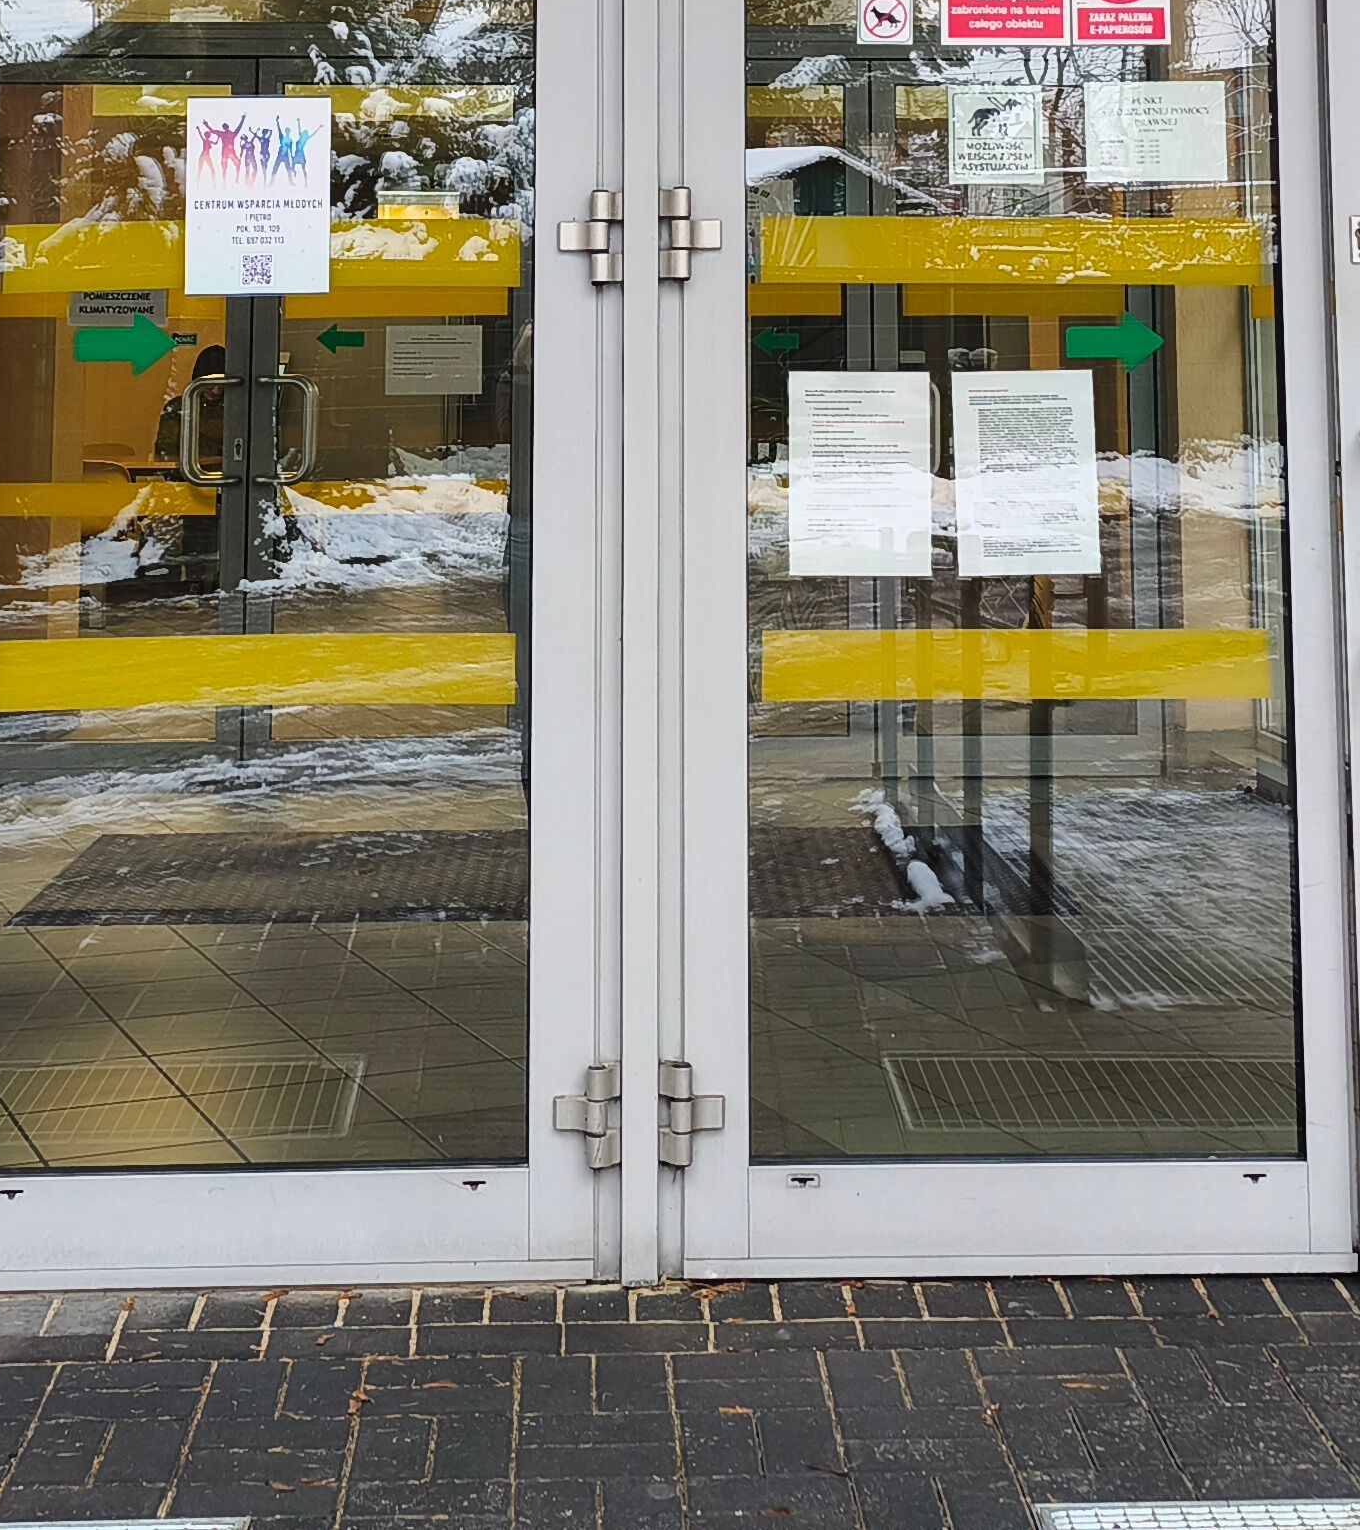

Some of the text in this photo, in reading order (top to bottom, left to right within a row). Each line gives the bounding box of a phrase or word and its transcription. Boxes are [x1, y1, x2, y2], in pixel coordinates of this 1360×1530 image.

[951, 5, 1007, 14] zabronione
[1025, 6, 1060, 14] terenie
[1089, 13, 1153, 22] ZAKAZ PALENIA
[1006, 19, 1043, 29] obiektu
[194, 199, 322, 209] CENTRUM WSPARCIA MŁODYCH
[250, 214, 271, 222] PIĘTRO
[84, 292, 151, 300] POMIESZCZENIE
[79, 306, 154, 314] KLIMATYZOWANE
